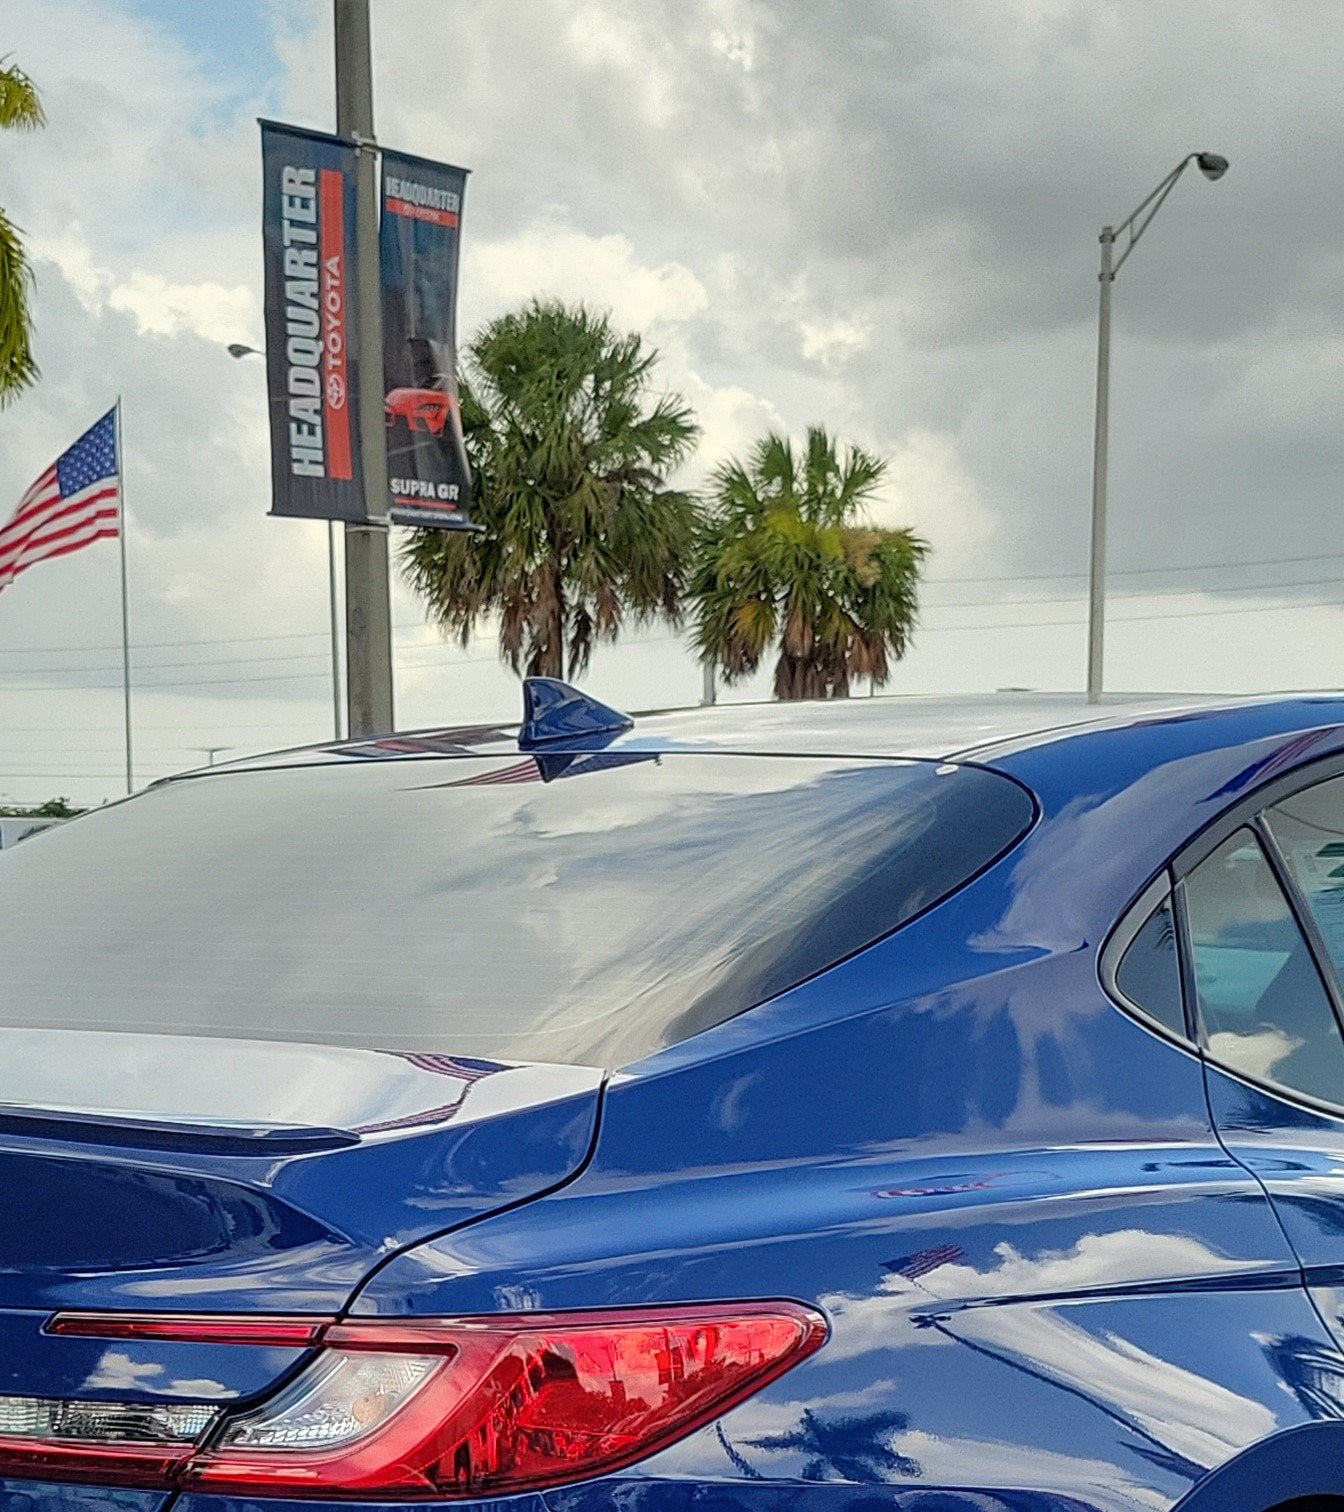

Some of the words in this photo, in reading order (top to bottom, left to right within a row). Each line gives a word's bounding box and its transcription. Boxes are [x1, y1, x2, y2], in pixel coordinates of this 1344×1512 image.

[282, 165, 325, 477] HEADQUARTER
[324, 256, 342, 369] TOYOTA
[390, 478, 436, 498] SUPRA
[437, 483, 460, 501] GR
